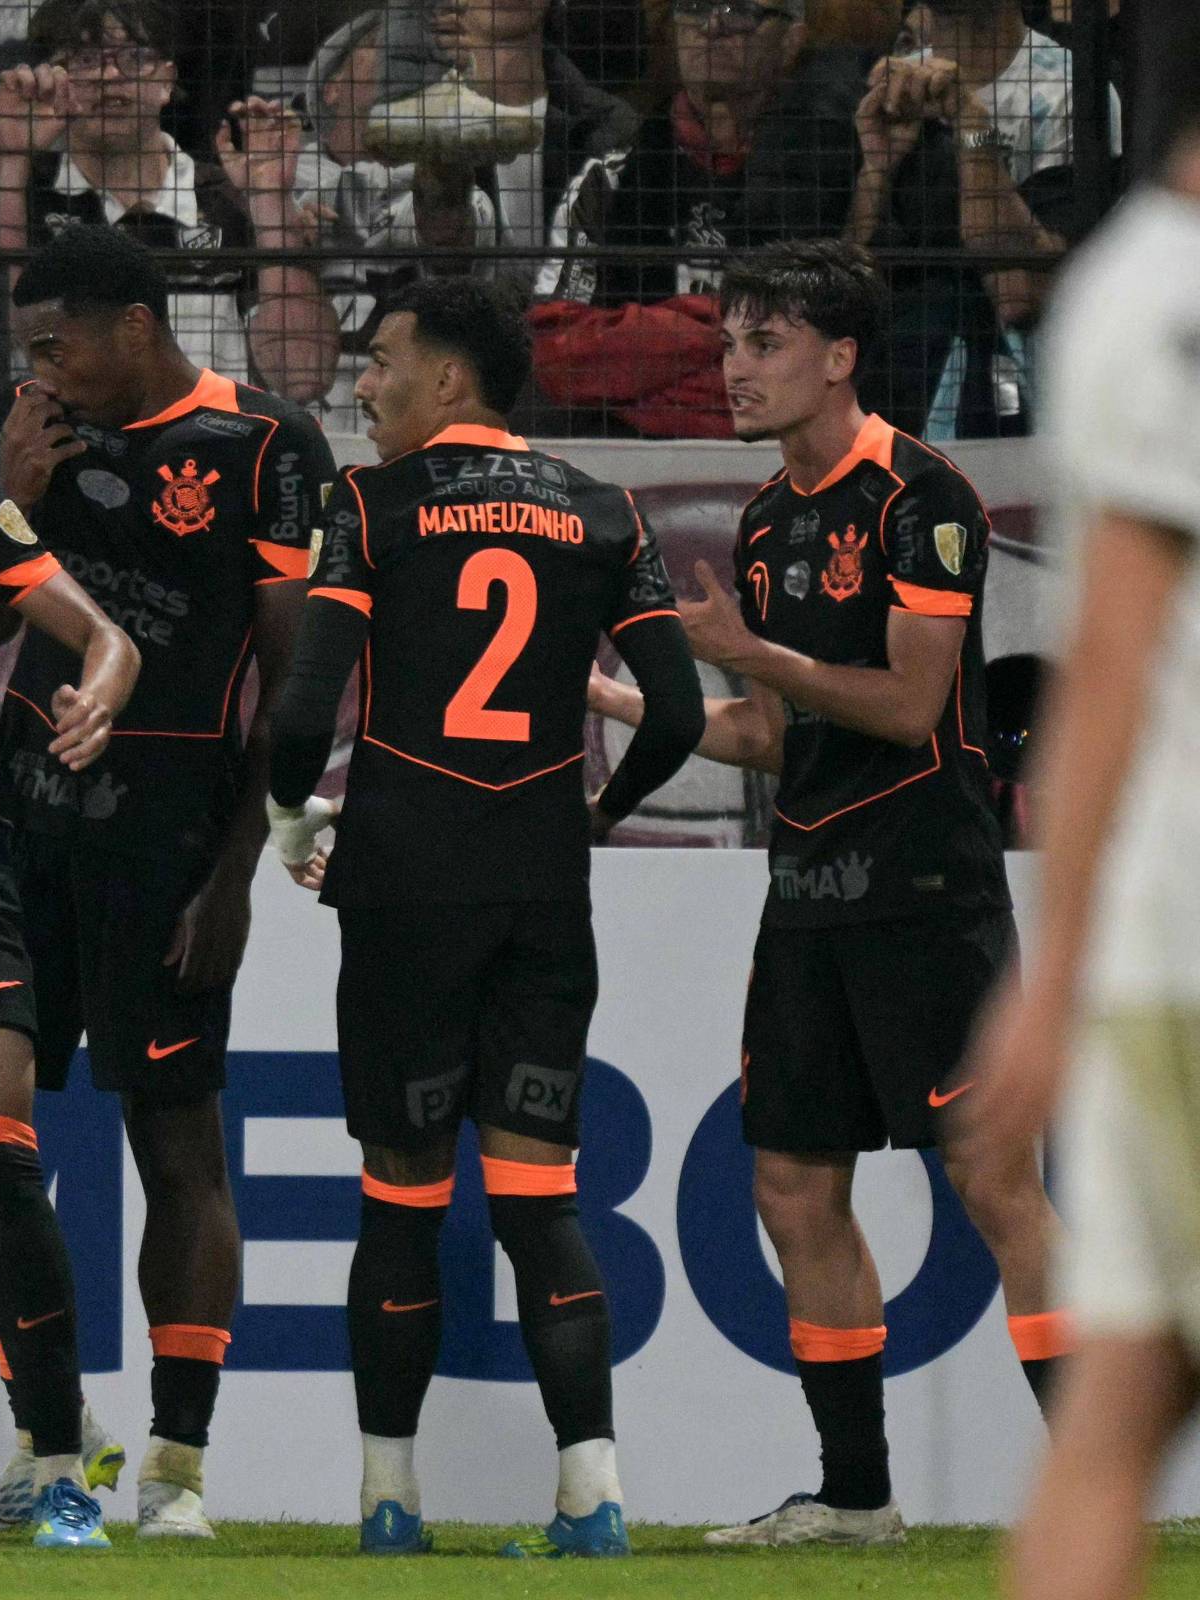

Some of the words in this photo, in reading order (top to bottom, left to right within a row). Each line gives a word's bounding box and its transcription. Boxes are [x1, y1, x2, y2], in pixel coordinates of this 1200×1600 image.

[424, 453, 537, 483] EZZE
[269, 474, 304, 540] bmg
[434, 479, 518, 497] SEGURO
[522, 481, 571, 506] AUTO
[418, 502, 585, 544] MATHEUZINHO
[443, 547, 539, 742] 2
[518, 1075, 566, 1112] px
